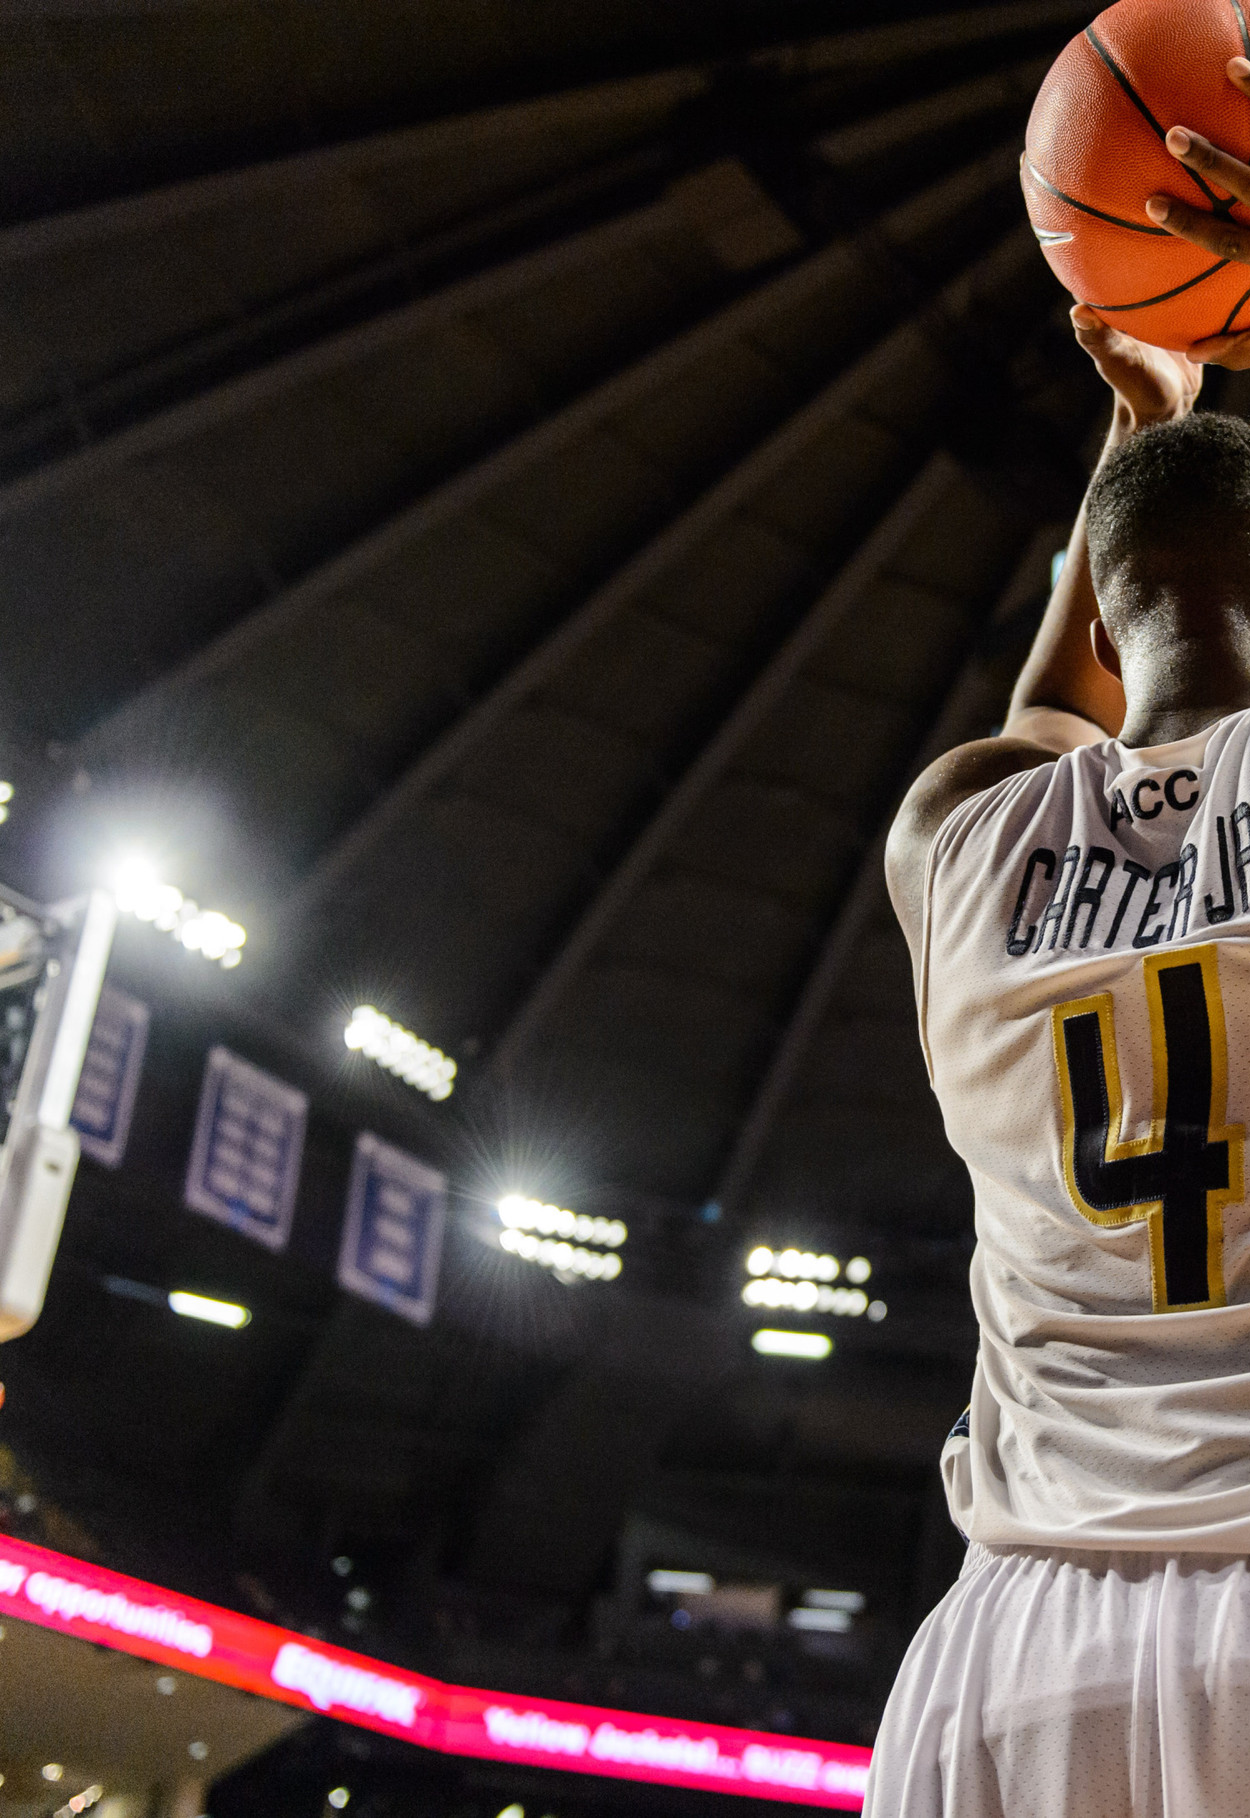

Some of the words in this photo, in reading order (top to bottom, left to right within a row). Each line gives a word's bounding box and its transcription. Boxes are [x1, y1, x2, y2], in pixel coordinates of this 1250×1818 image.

[1109, 768, 1200, 833] ACC
[1005, 843, 1199, 957] CARTER
[1050, 943, 1247, 1314] 4
